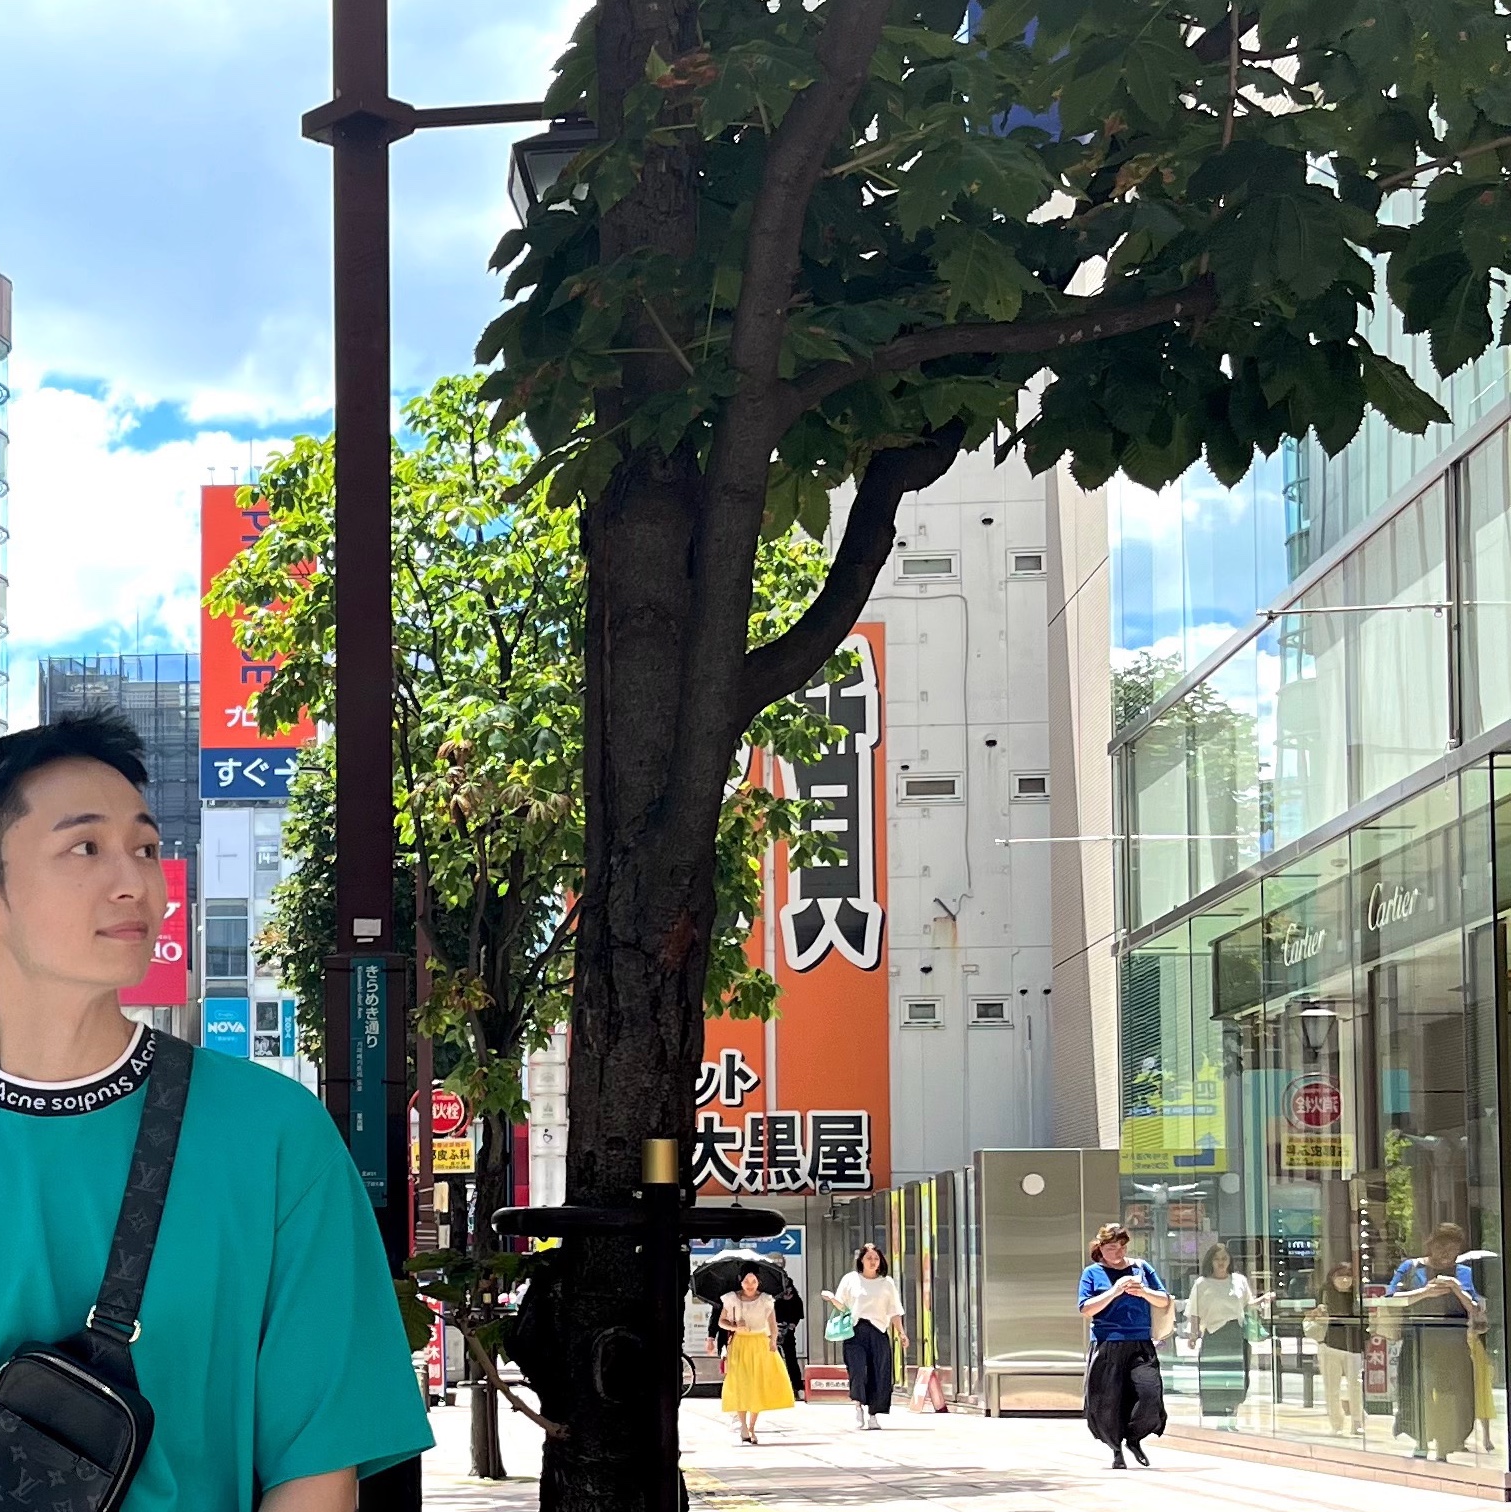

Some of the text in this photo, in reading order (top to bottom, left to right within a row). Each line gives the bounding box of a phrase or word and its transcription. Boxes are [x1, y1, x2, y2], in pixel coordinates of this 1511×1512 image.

[213, 757, 270, 788] すぐ
[1367, 882, 1420, 932] Cartier
[1283, 922, 1327, 967] Cartier
[365, 965, 380, 1049] きらめき通り
[207, 1021, 246, 1034] NOVA
[284, 1016, 292, 1039] NOVA
[50, 1075, 135, 1111] Studios
[692, 1110, 874, 1193] 大黒屋
